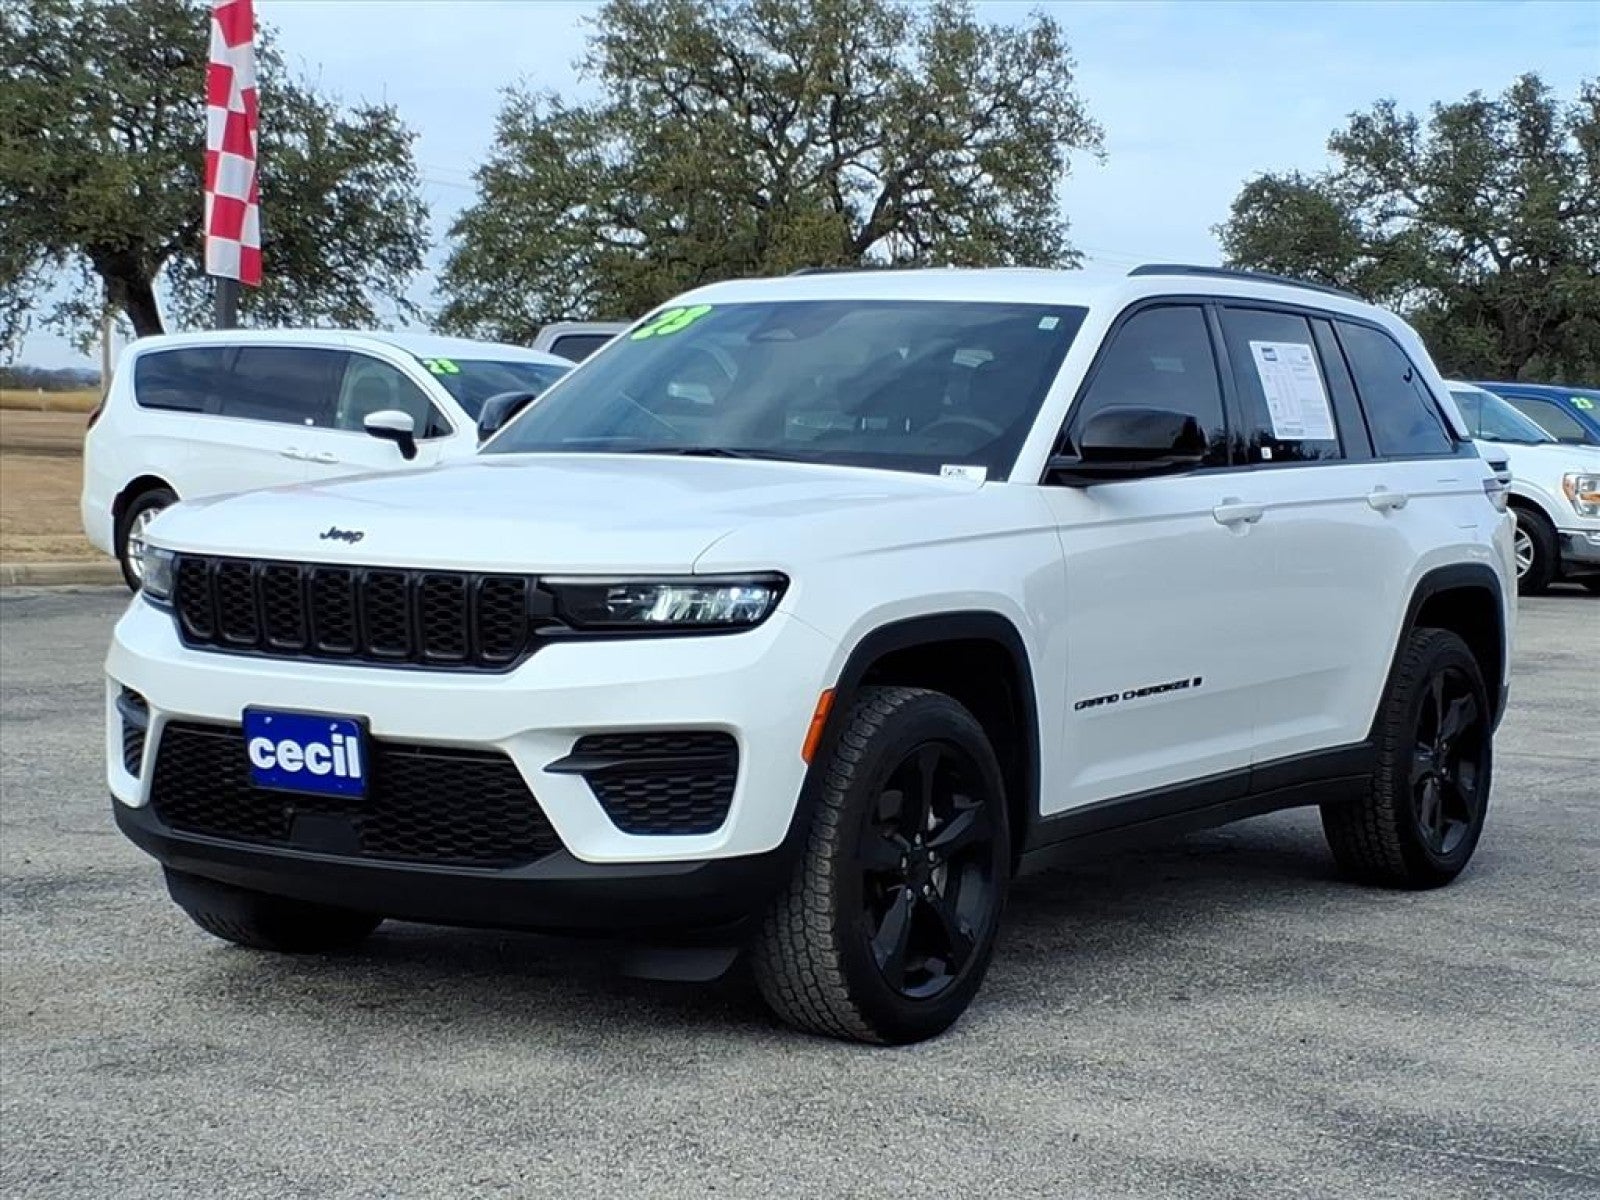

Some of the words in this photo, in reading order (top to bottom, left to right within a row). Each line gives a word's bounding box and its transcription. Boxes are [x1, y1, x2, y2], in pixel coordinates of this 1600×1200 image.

[630, 304, 712, 340] 23
[1570, 396, 1594, 409] 23
[319, 525, 365, 545] Jeep
[1074, 693, 1120, 711] GRAND
[1122, 678, 1190, 701] CHEROKEE
[249, 733, 361, 779] cecil
